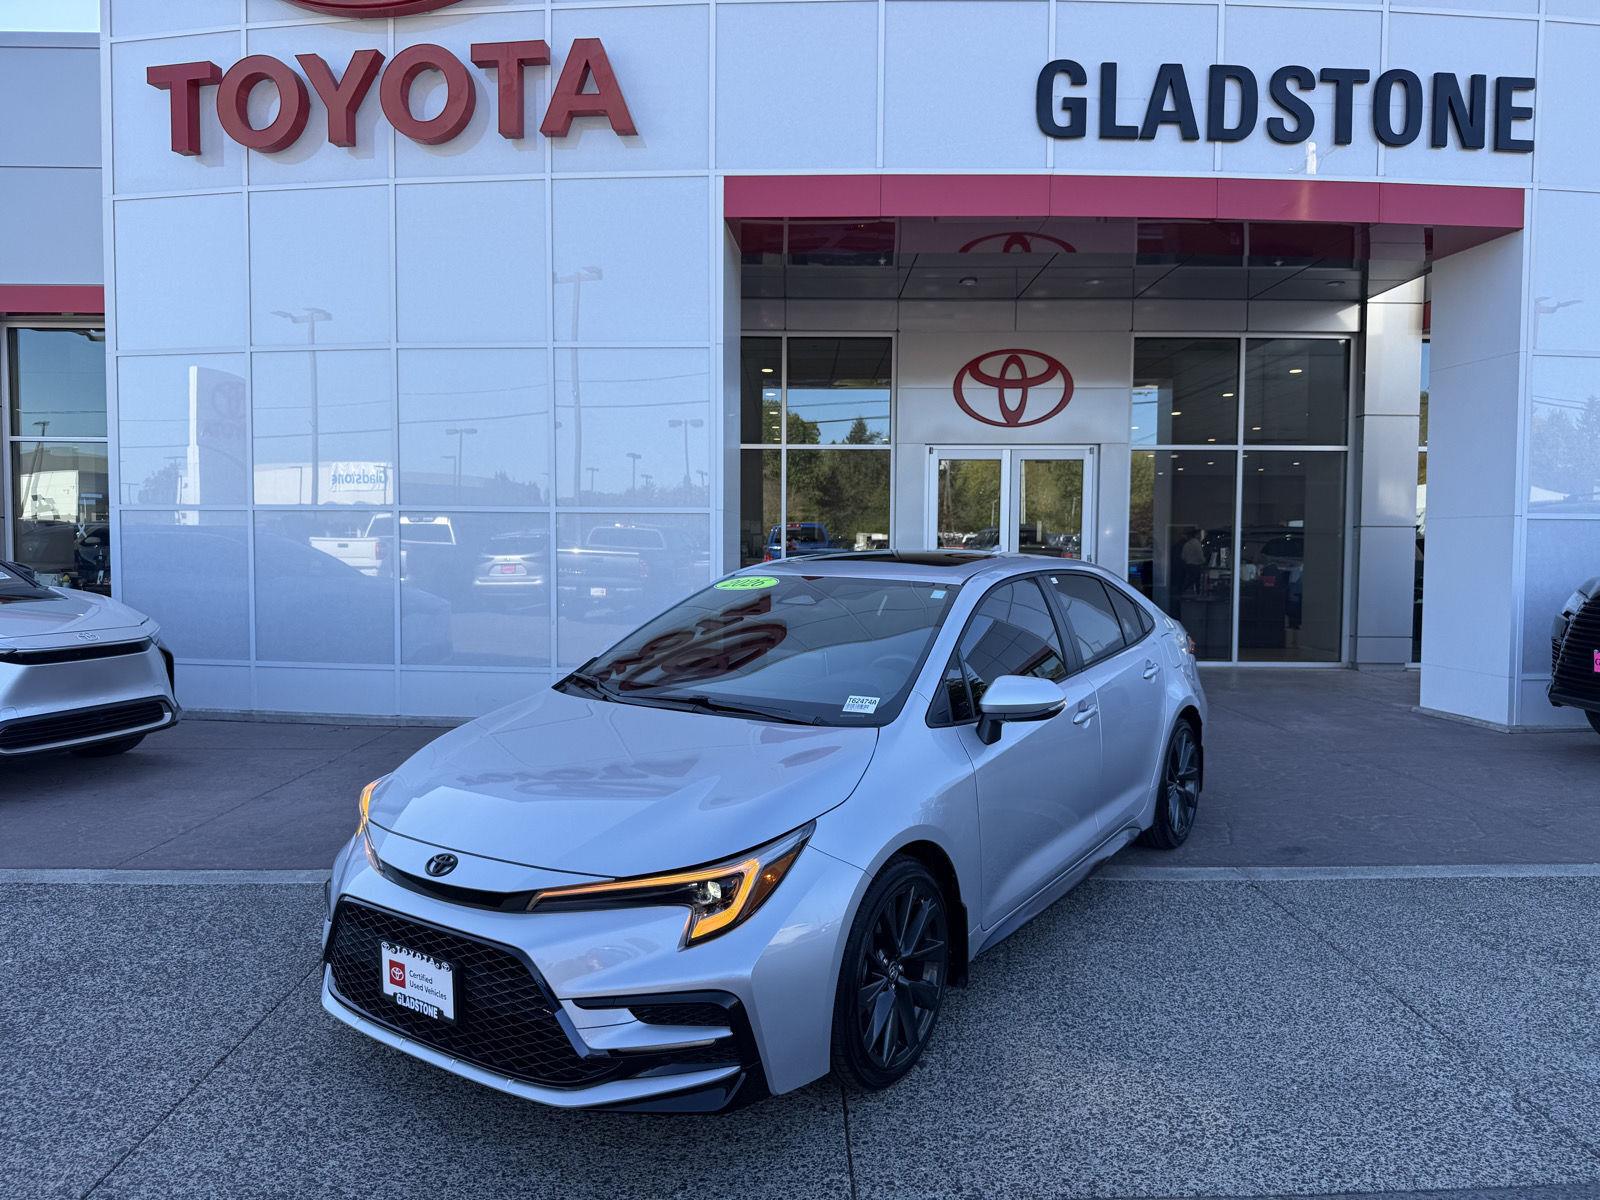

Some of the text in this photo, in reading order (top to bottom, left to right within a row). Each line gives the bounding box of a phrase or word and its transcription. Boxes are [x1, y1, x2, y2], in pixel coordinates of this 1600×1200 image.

[146, 38, 638, 156] TOYOTA
[1036, 59, 1535, 153] GLADSTONE
[395, 945, 435, 966] TOYOTA
[408, 970, 433, 984] Certified
[409, 980, 447, 1000] Used Vehicles
[396, 993, 438, 1019] GLADSTONE
